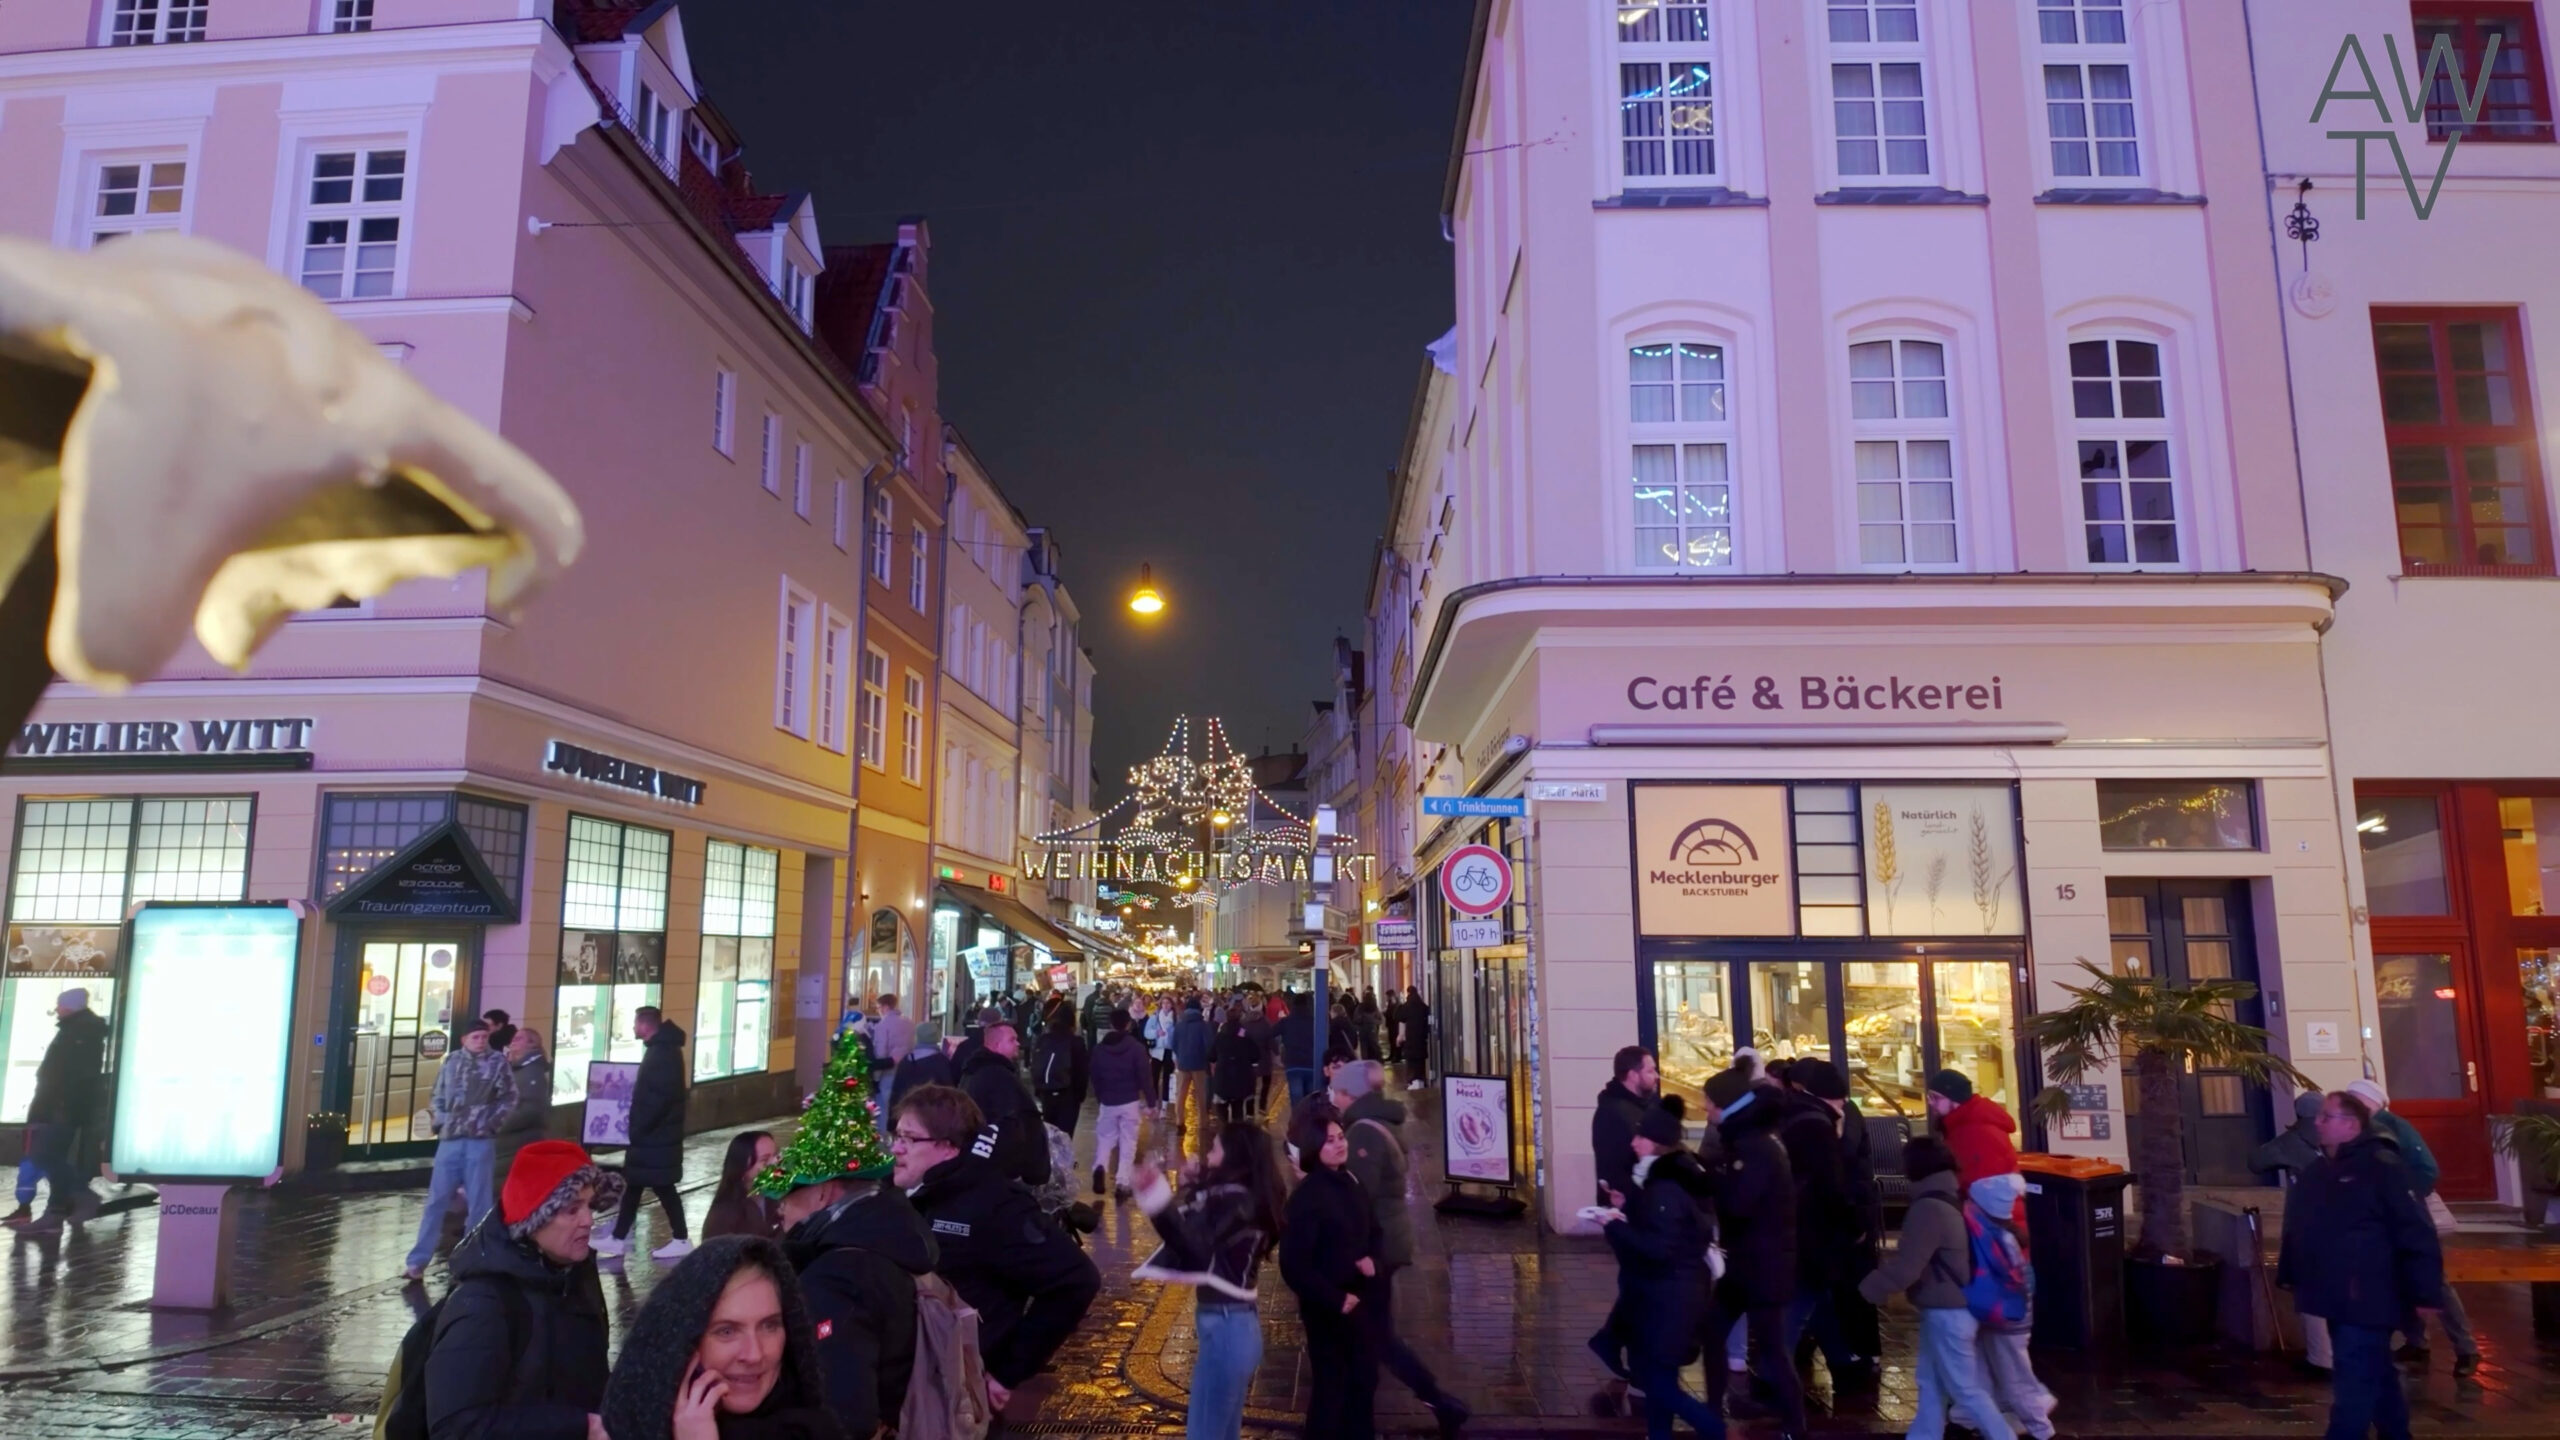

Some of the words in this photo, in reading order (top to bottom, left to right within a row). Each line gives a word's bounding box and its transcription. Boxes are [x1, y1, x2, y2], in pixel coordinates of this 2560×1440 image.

[1627, 674, 1736, 710] Café
[1751, 676, 1784, 710] &
[1800, 675, 2003, 710] Bäckerei
[190, 718, 313, 751] WITT
[1457, 801, 1519, 814] Trinkbrunnen
[1901, 810, 1957, 820] Natürlich
[1022, 851, 1376, 882] WEIHNACHTSMAKT
[1650, 870, 1780, 888] Mecklenburger
[1682, 888, 1748, 897] BACKSTUBEN
[2056, 884, 2076, 900] 15
[359, 900, 491, 914] Trauringzentrum
[1456, 928, 1485, 941] 10-19
[1490, 928, 1497, 939] h
[162, 1204, 219, 1215] JCDecaux
